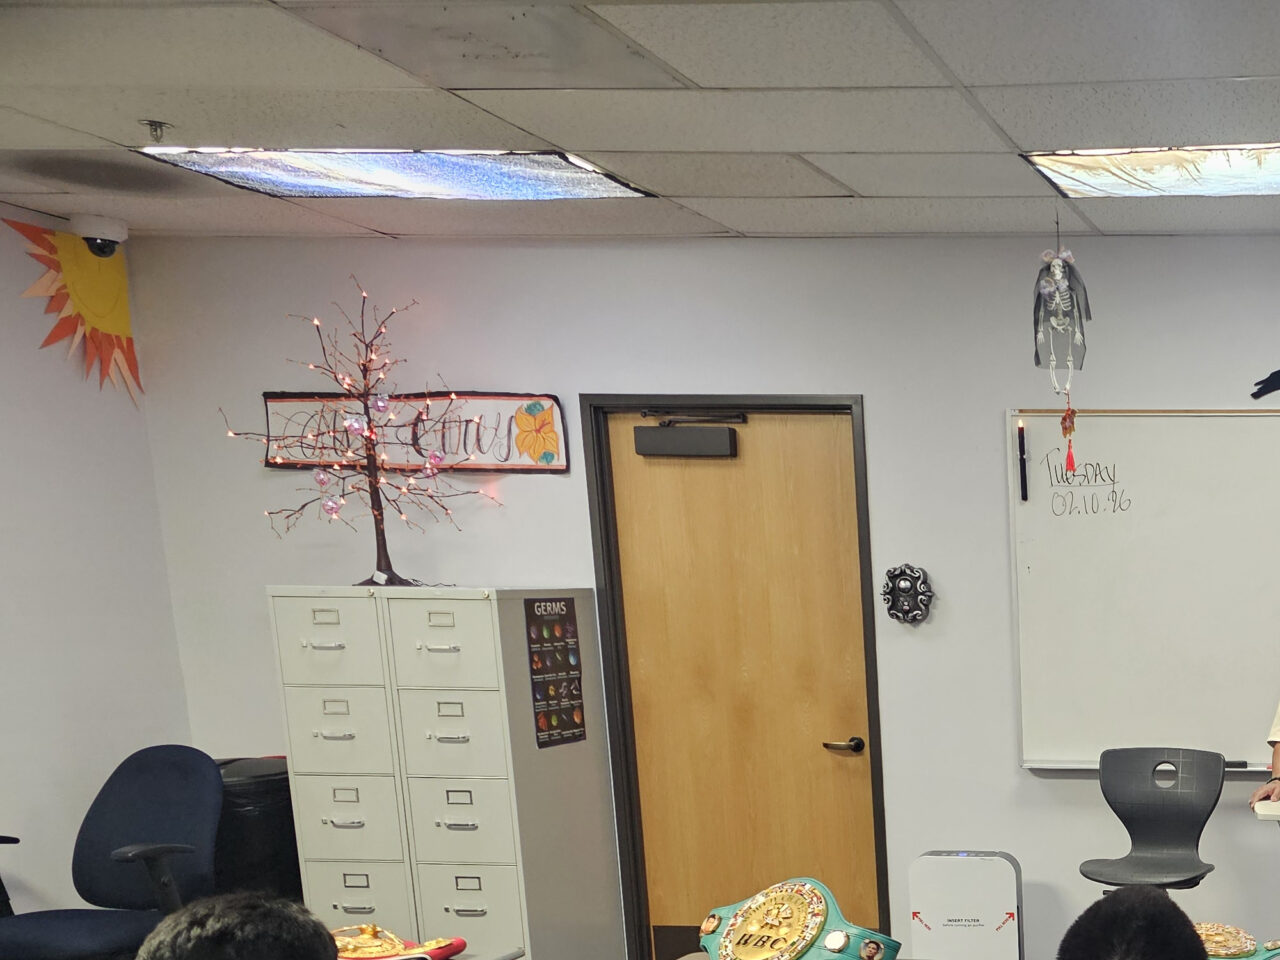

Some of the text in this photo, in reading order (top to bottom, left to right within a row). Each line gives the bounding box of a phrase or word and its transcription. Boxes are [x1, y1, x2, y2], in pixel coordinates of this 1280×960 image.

[1052, 489, 1132, 517] 02.10.26
[534, 602, 567, 616] GERMS
[735, 933, 788, 950] WBC
